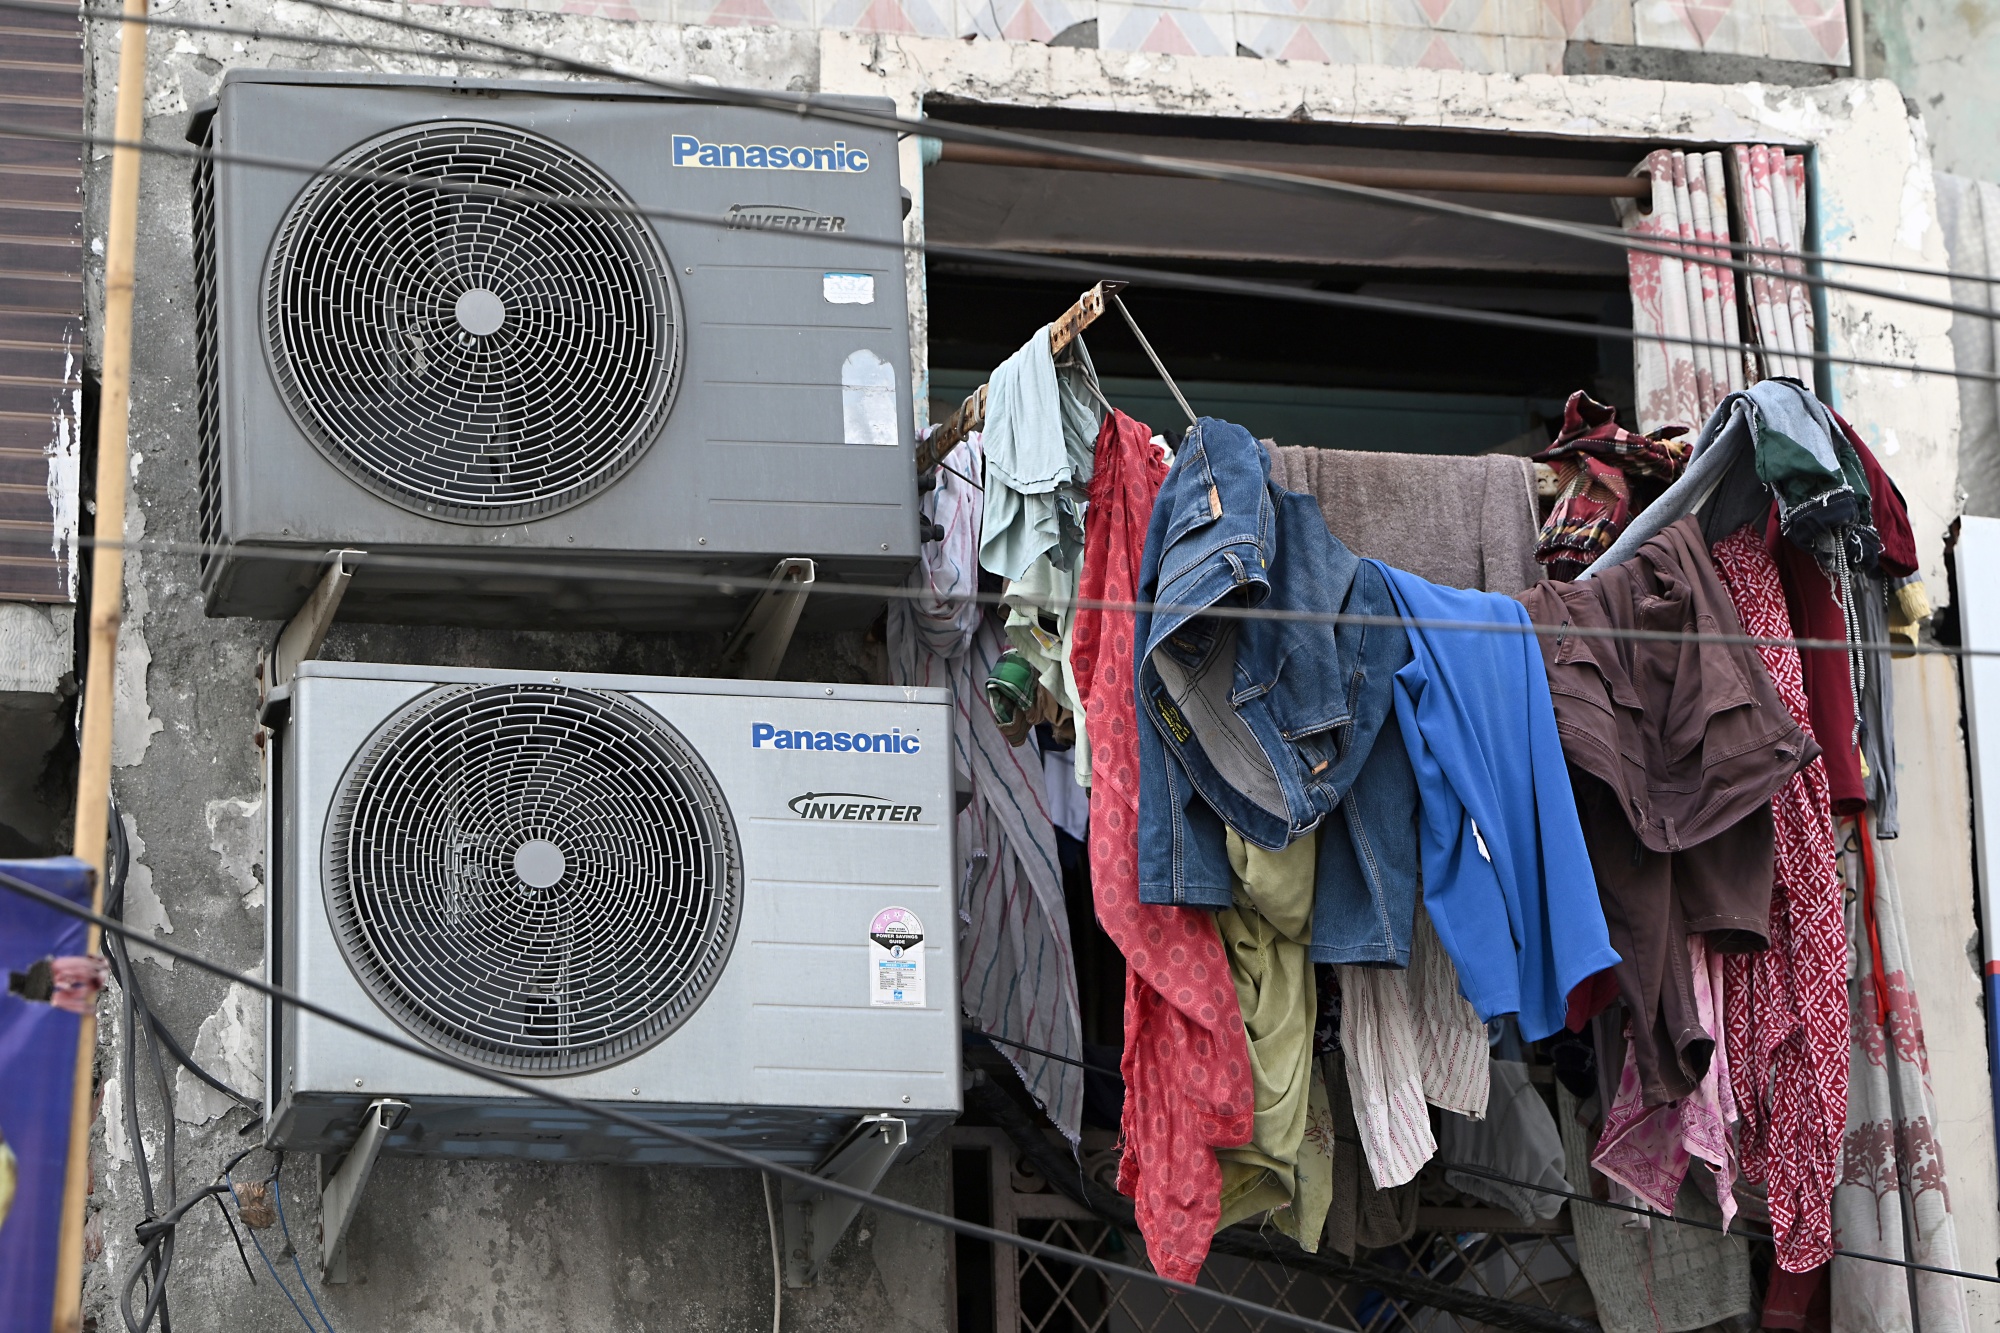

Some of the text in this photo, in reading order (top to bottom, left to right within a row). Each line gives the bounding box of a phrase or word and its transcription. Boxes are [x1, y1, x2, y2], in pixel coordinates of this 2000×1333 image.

[672, 134, 869, 172] Panasonic
[727, 213, 845, 233] INVERTER
[752, 722, 921, 755] Panasonic
[800, 802, 922, 822] INVERTER
